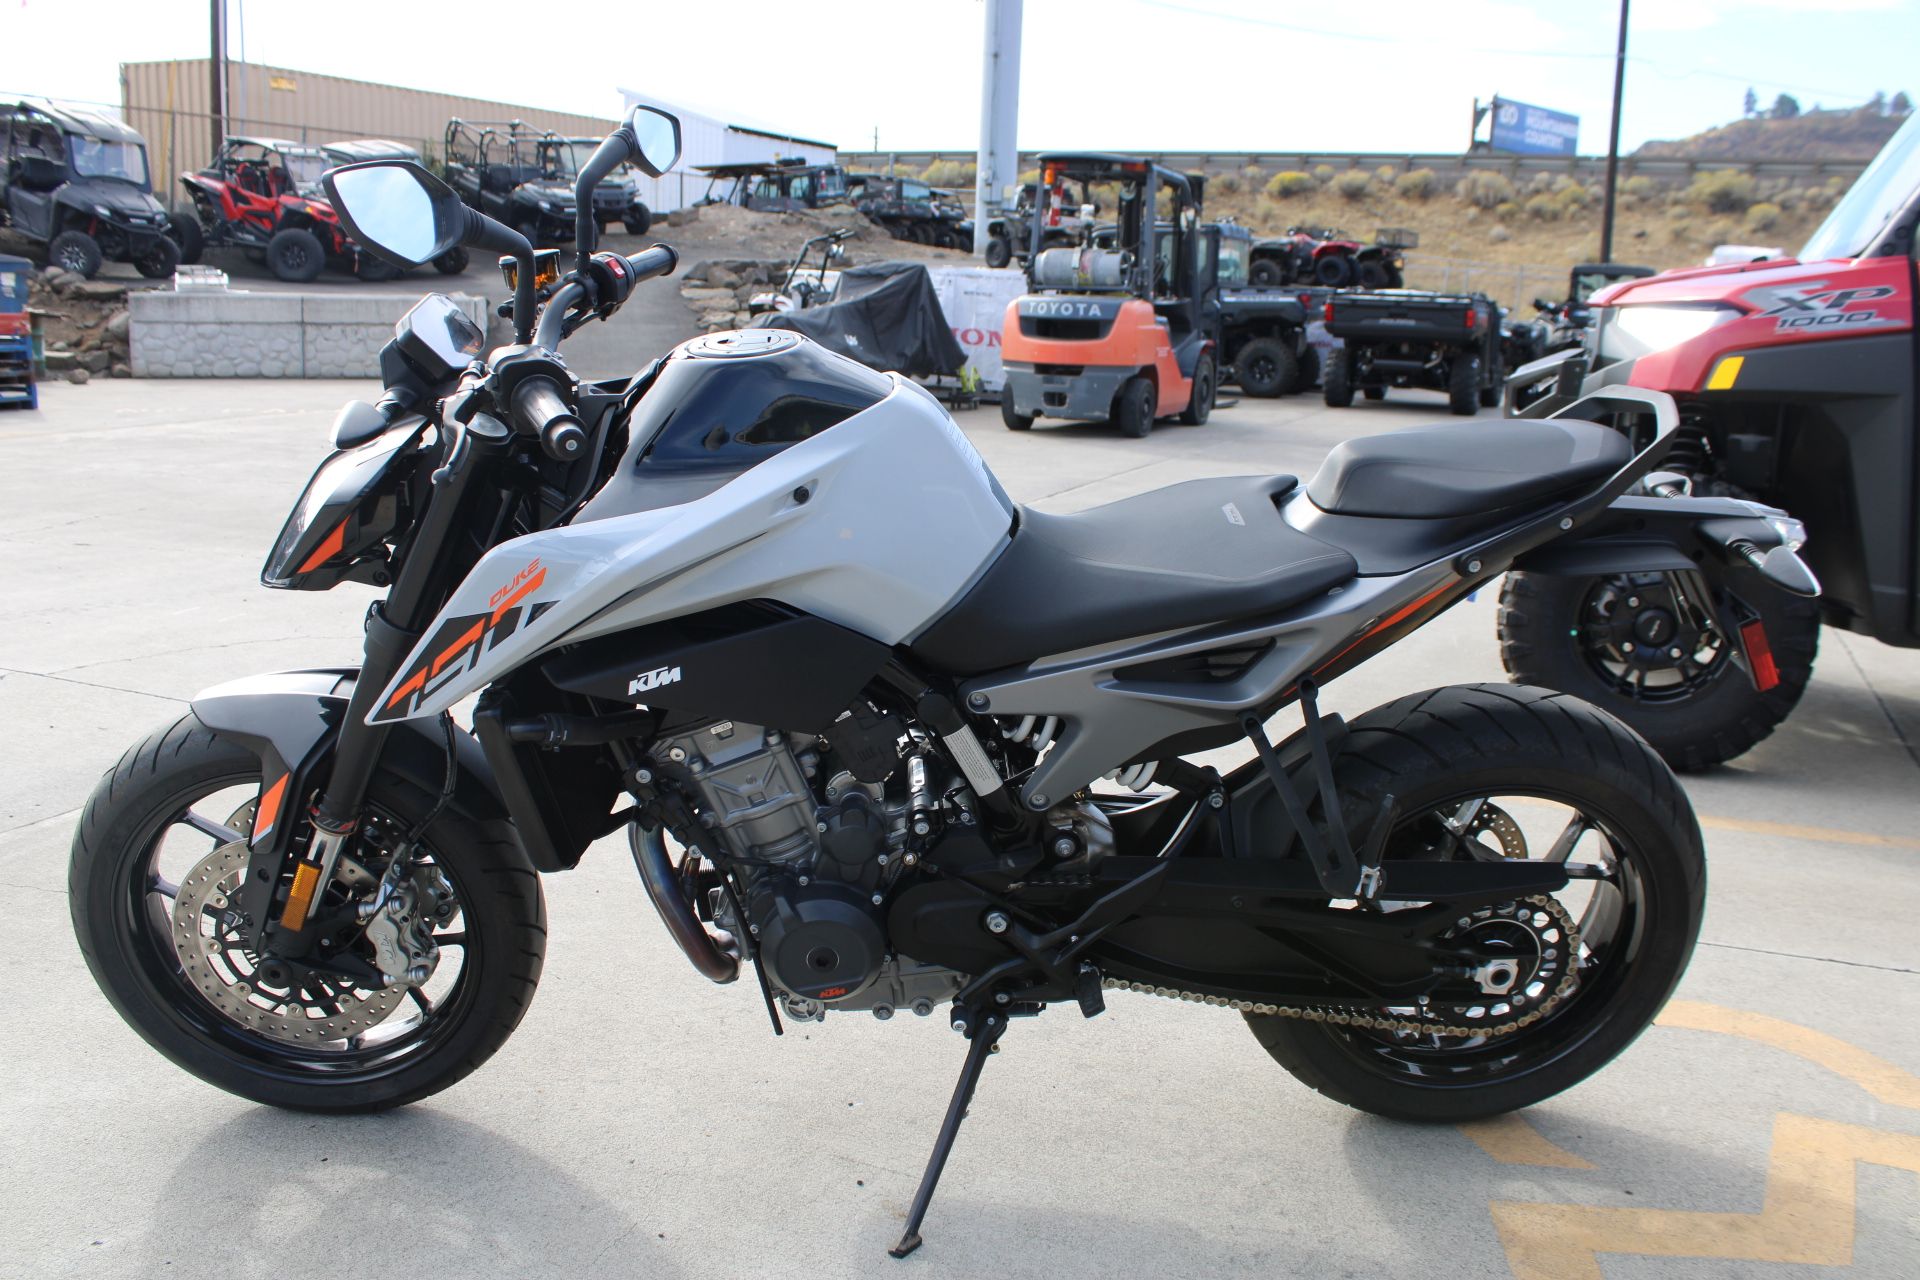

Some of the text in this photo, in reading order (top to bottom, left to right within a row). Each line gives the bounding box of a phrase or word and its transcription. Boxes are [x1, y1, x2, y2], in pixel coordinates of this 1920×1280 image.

[1028, 302, 1102, 316] TOYOTA
[1760, 286, 1896, 317] XP
[1778, 311, 1875, 328] 1000
[489, 556, 541, 607] DUKE
[628, 666, 681, 695] KTM
[819, 987, 847, 998] KTM
